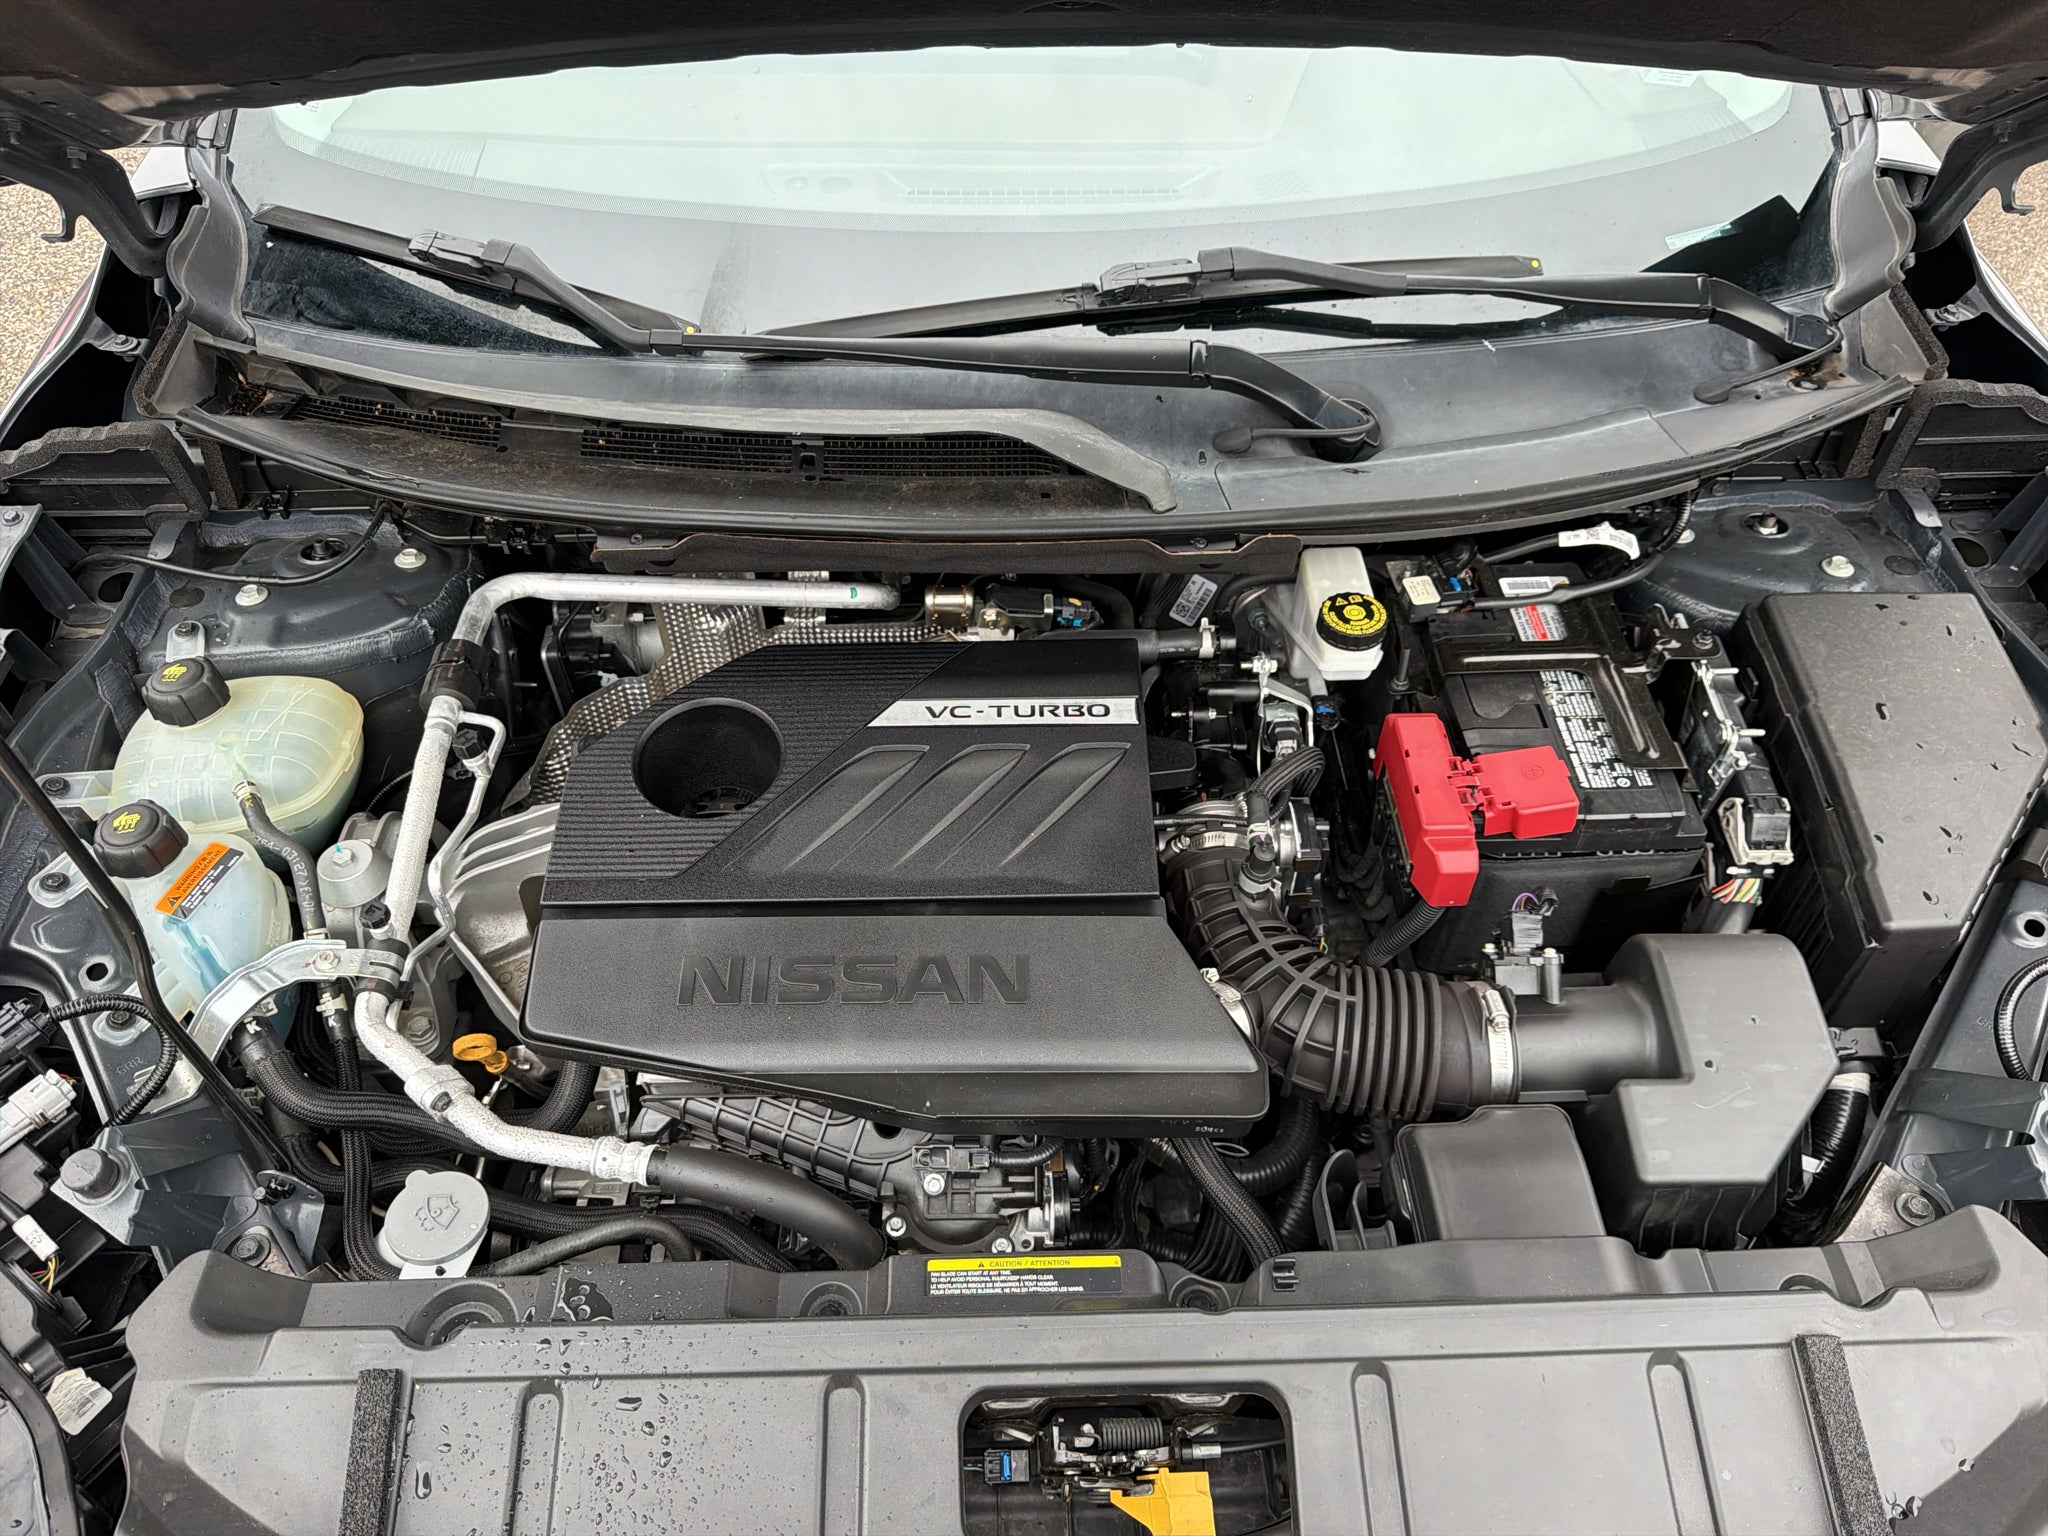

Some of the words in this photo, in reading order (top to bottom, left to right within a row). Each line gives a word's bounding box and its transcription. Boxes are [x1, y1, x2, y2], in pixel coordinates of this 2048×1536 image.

[925, 704, 1111, 719] VC-TURBO
[175, 865, 201, 891] WARNING
[182, 850, 222, 893] AVERTISSEMENT
[677, 954, 1030, 1006] NISSAN
[246, 1020, 262, 1034] K
[327, 1016, 338, 1028] K
